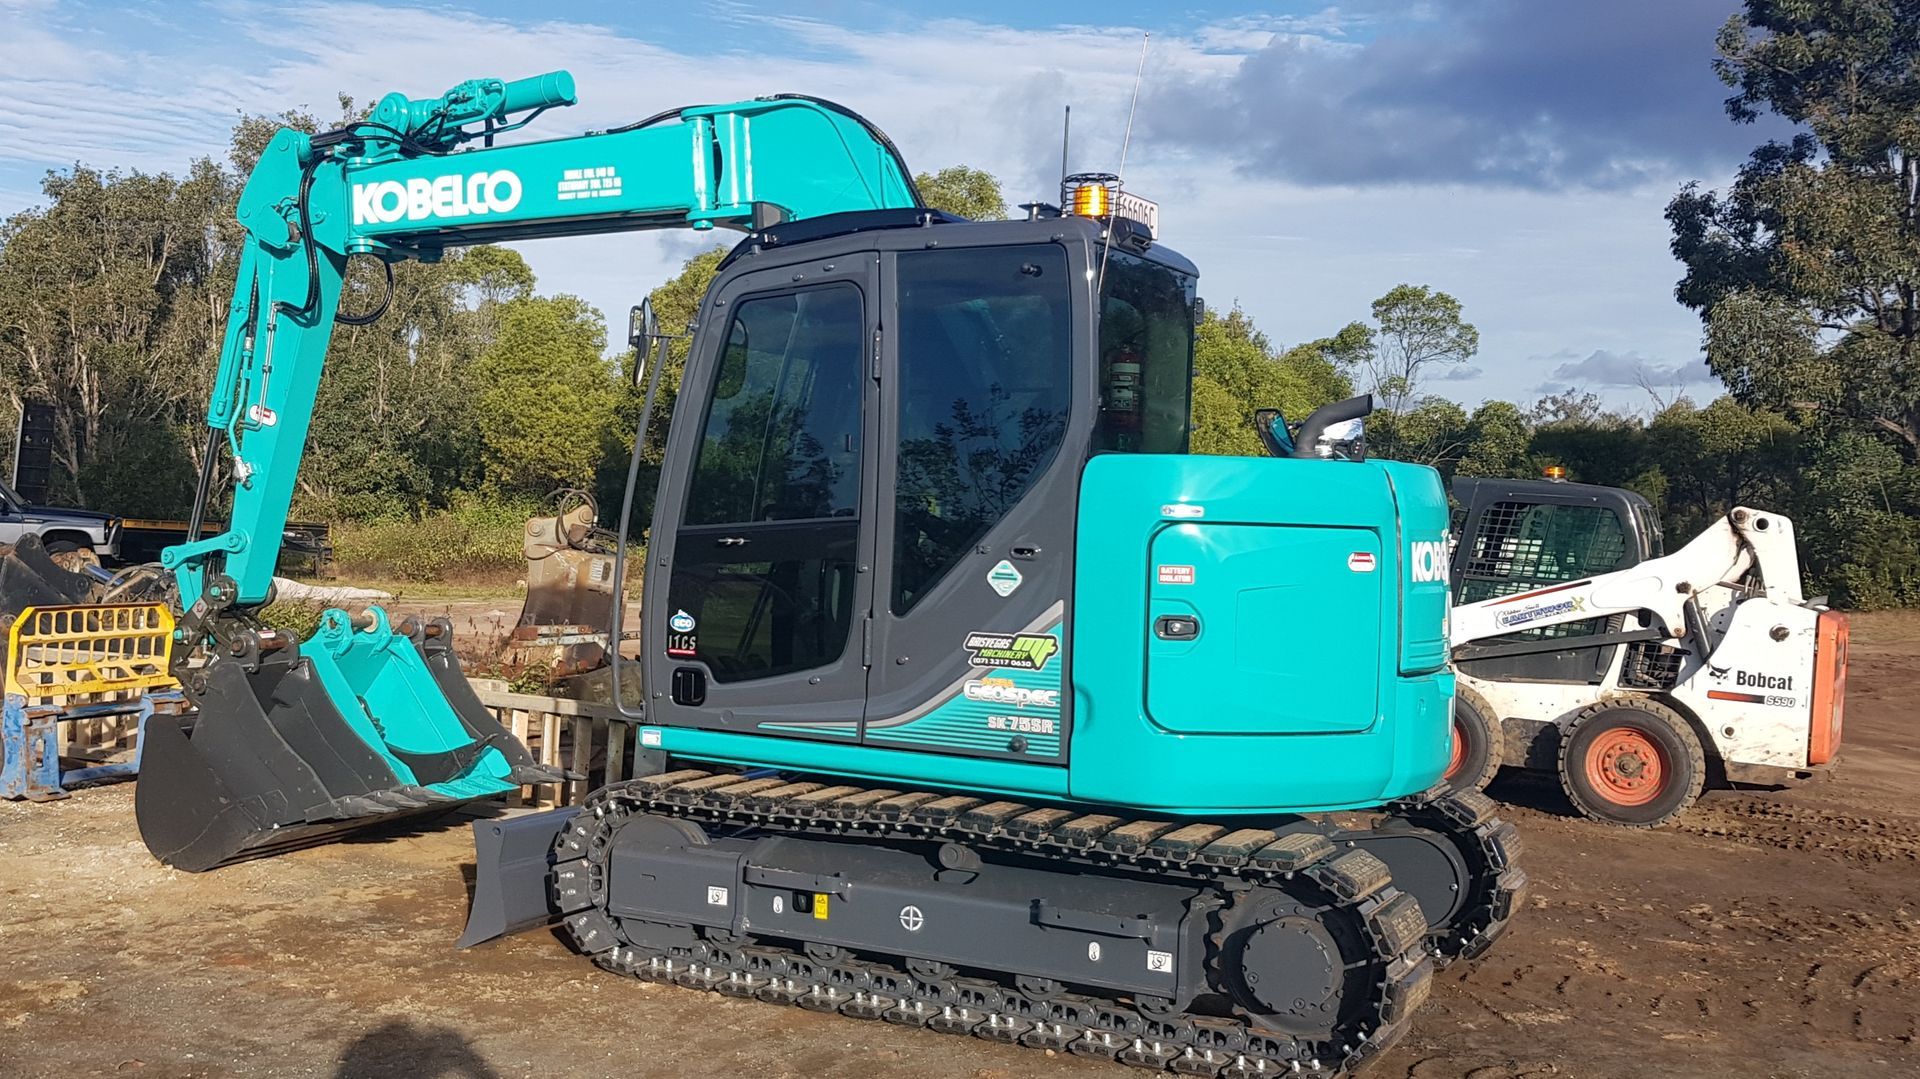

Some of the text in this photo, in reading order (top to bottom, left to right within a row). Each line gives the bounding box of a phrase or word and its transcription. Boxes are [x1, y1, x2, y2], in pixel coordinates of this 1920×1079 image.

[353, 169, 522, 226] KOBELCO
[673, 617, 692, 628] ECO
[668, 634, 697, 650] ITCS
[979, 648, 1028, 660] MACHINERY
[1010, 660, 1032, 668] 0630
[1736, 670, 1793, 691] Bobcat
[1766, 695, 1796, 708] S590
